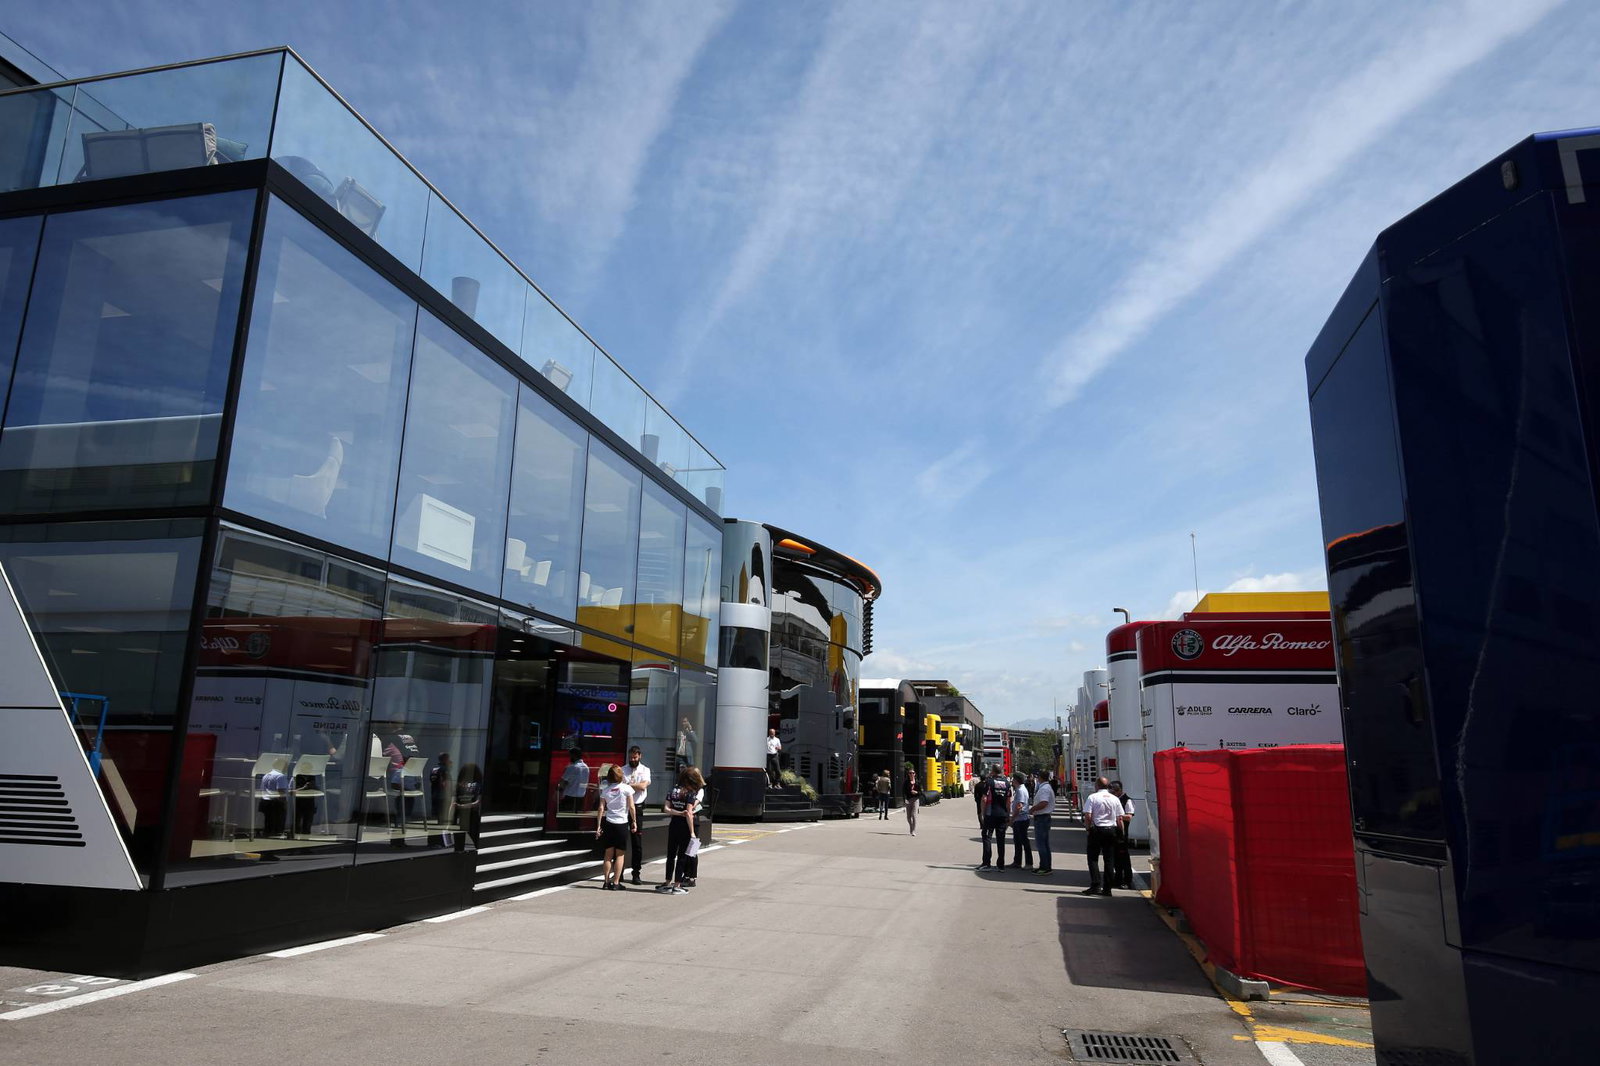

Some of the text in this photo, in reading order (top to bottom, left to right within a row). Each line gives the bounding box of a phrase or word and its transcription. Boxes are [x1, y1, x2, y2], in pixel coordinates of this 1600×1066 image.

[1212, 632, 1330, 656] Alfa Romeo
[1287, 705, 1318, 716] Claro
